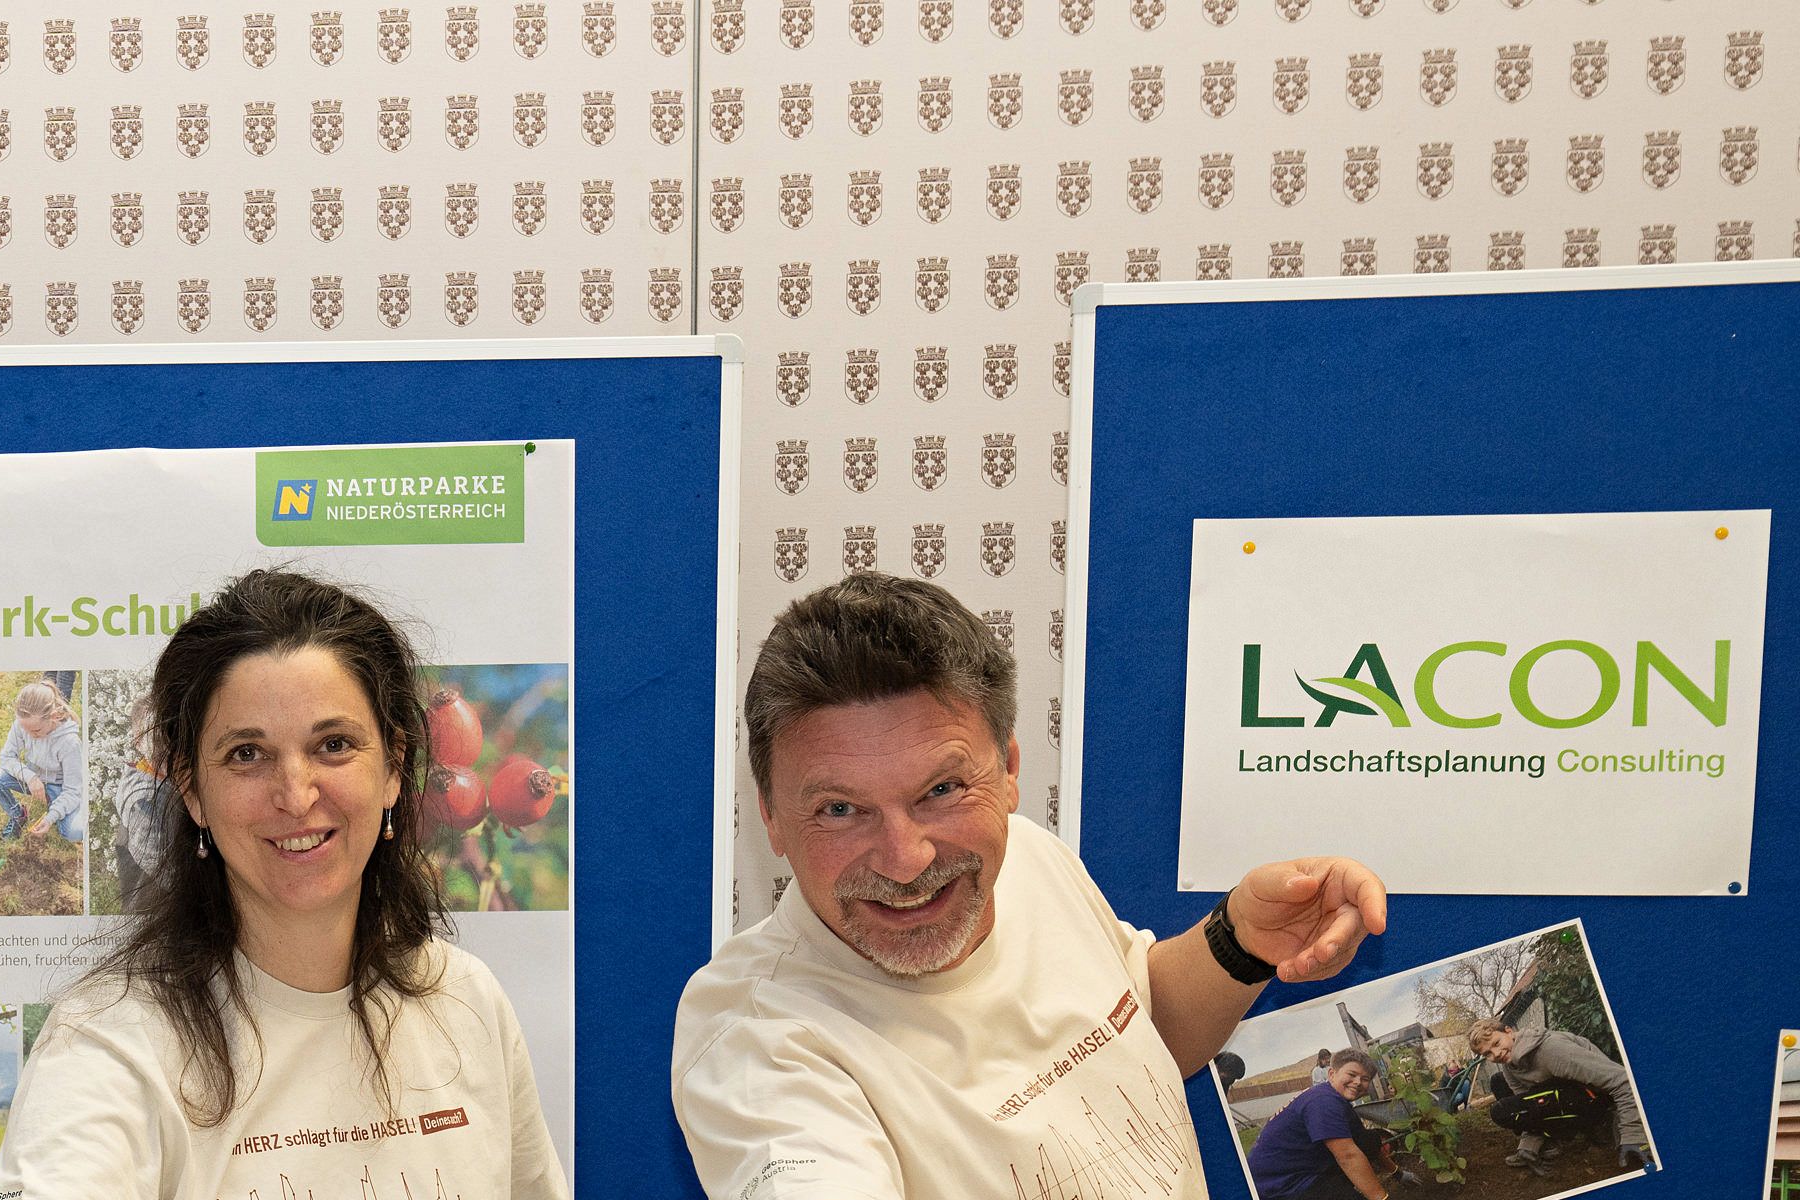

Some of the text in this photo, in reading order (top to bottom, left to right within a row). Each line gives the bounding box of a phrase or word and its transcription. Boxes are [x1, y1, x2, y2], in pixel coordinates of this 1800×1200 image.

[326, 475, 506, 497] NATURPARKE
[326, 502, 506, 520] NIEDERÖSTERREICH
[1241, 639, 1732, 729] LACON
[1238, 748, 1725, 779] Landschaftsplanung Consulting
[43, 934, 68, 948] und
[35, 953, 88, 967] fruchten
[1053, 1059, 1073, 1079] die
[1067, 1023, 1115, 1065] HASEL!
[244, 1134, 282, 1154] HERZ
[285, 1127, 331, 1149] schlägt
[334, 1125, 348, 1143] für
[351, 1123, 369, 1141] die
[370, 1117, 417, 1139] HASEL!
